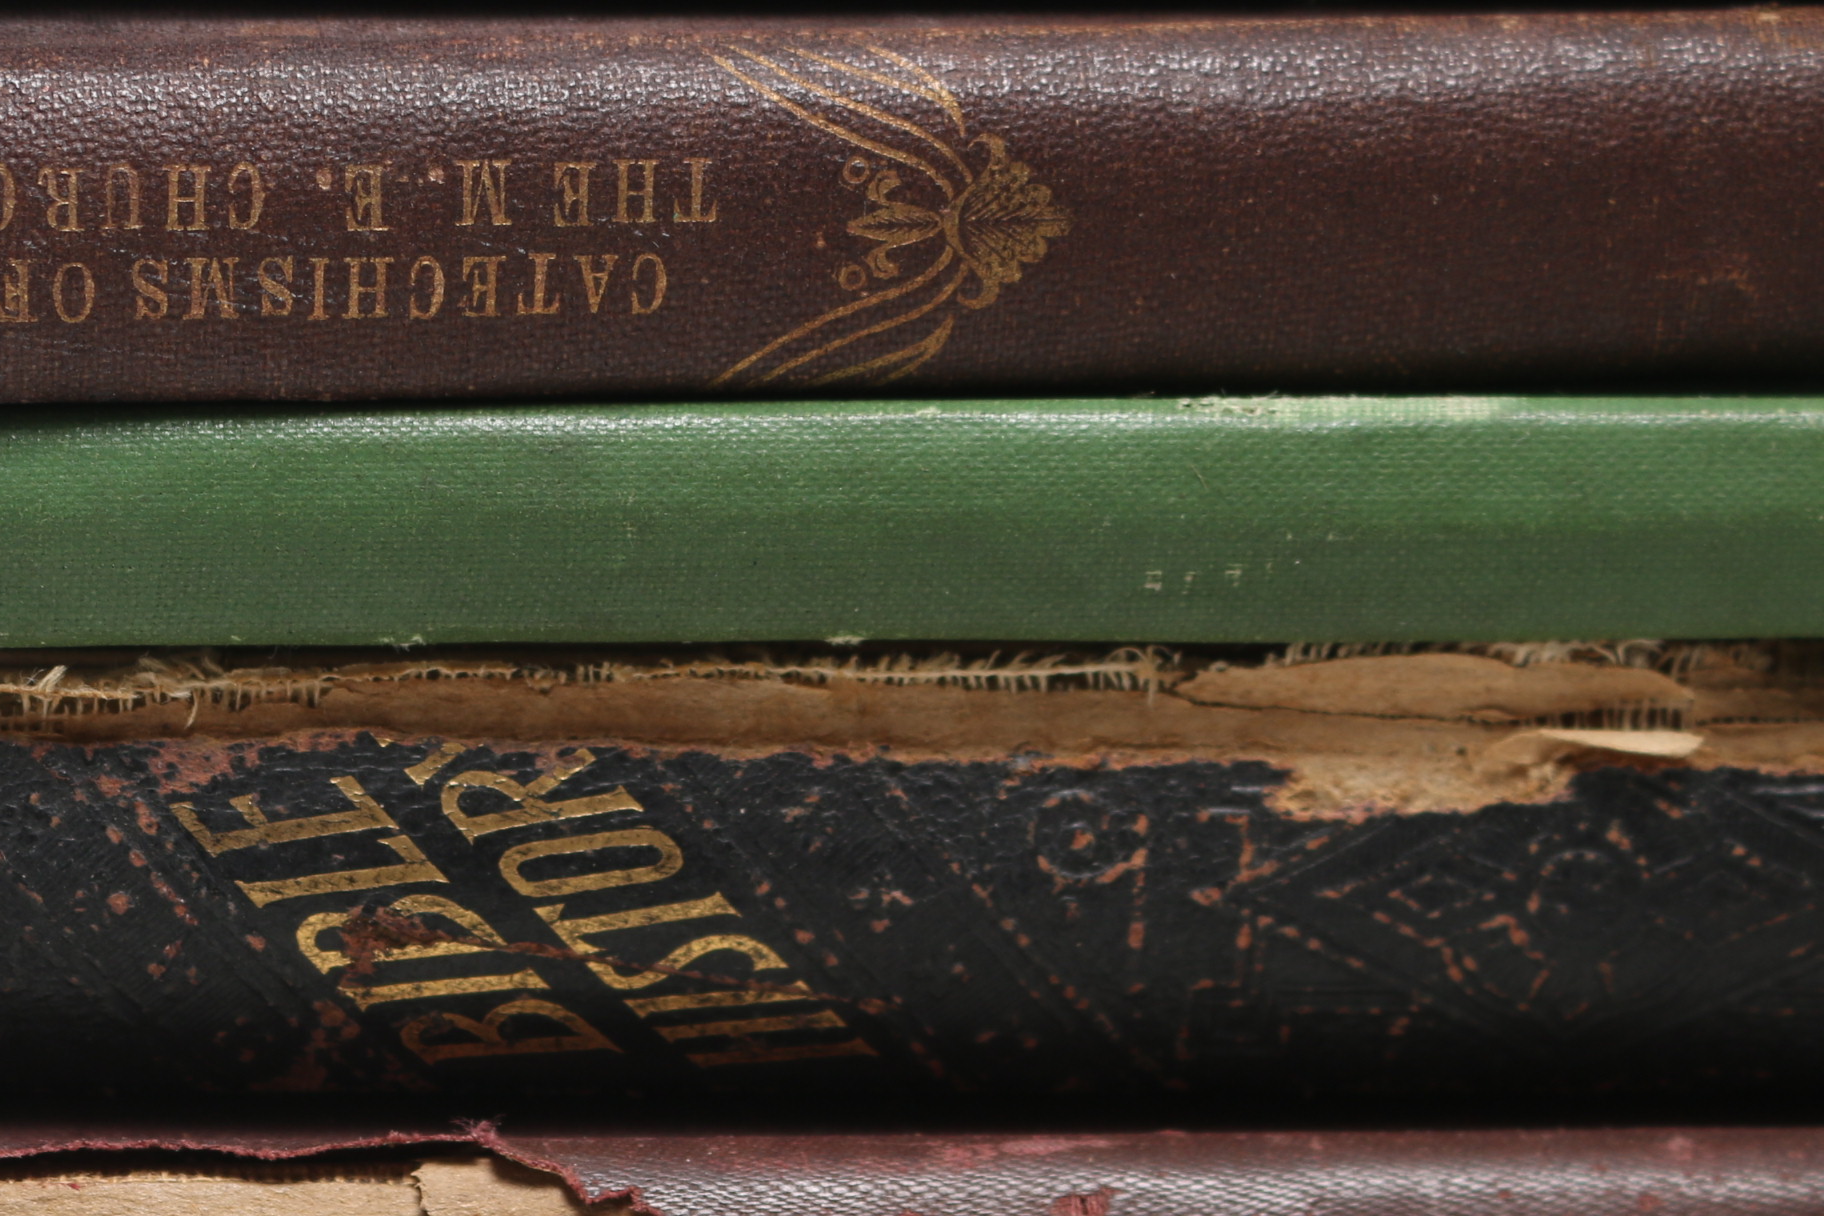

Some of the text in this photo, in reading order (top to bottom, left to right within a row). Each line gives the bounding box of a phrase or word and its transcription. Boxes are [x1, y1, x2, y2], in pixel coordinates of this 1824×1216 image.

[314, 162, 390, 232] E.
[425, 157, 514, 228] M.
[552, 156, 719, 227] THE
[131, 251, 670, 321] CATECHISMS
[167, 774, 626, 1067] BIBLE
